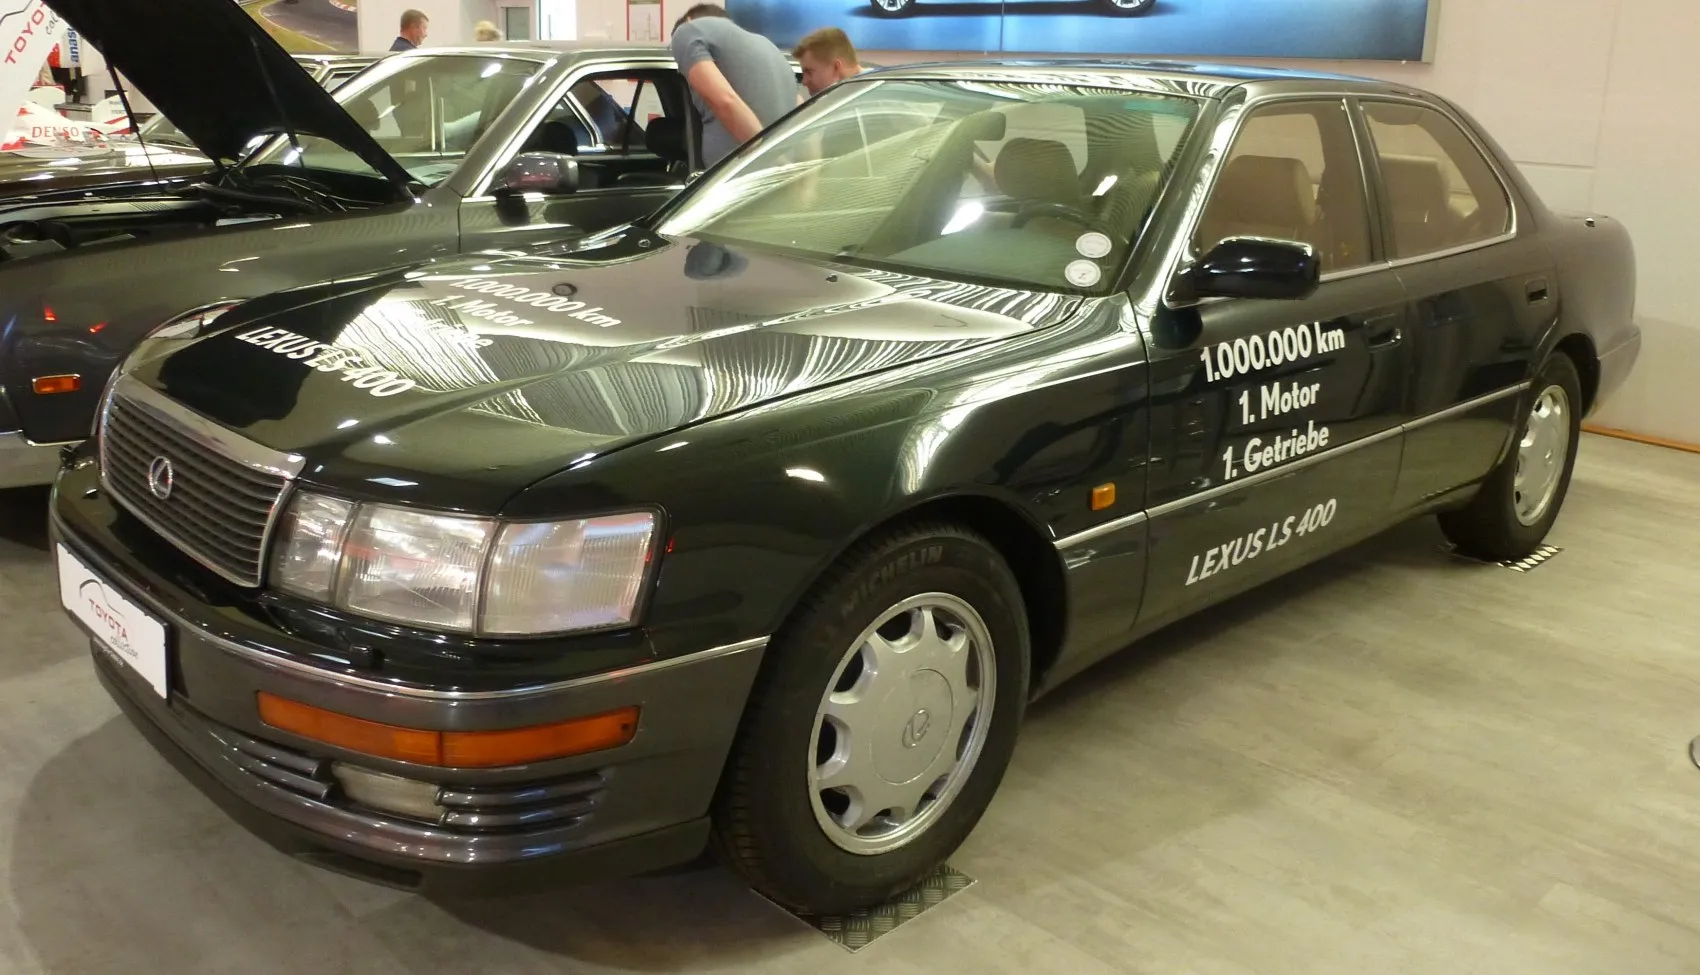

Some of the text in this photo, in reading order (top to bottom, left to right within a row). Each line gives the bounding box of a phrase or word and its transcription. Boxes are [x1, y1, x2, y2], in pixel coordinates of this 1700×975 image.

[31, 126, 79, 138] DENSO
[448, 299, 534, 327] Motor
[450, 278, 622, 328] 1.000.000 km
[235, 326, 416, 397] LEXUS LS 400
[1200, 321, 1346, 382] 1.000.000 km
[1239, 381, 1321, 425] 1. Motor
[1222, 420, 1330, 480] 1. Getriebe
[1185, 498, 1338, 586] LEXUS LS 400
[88, 598, 128, 641] TOYOTA
